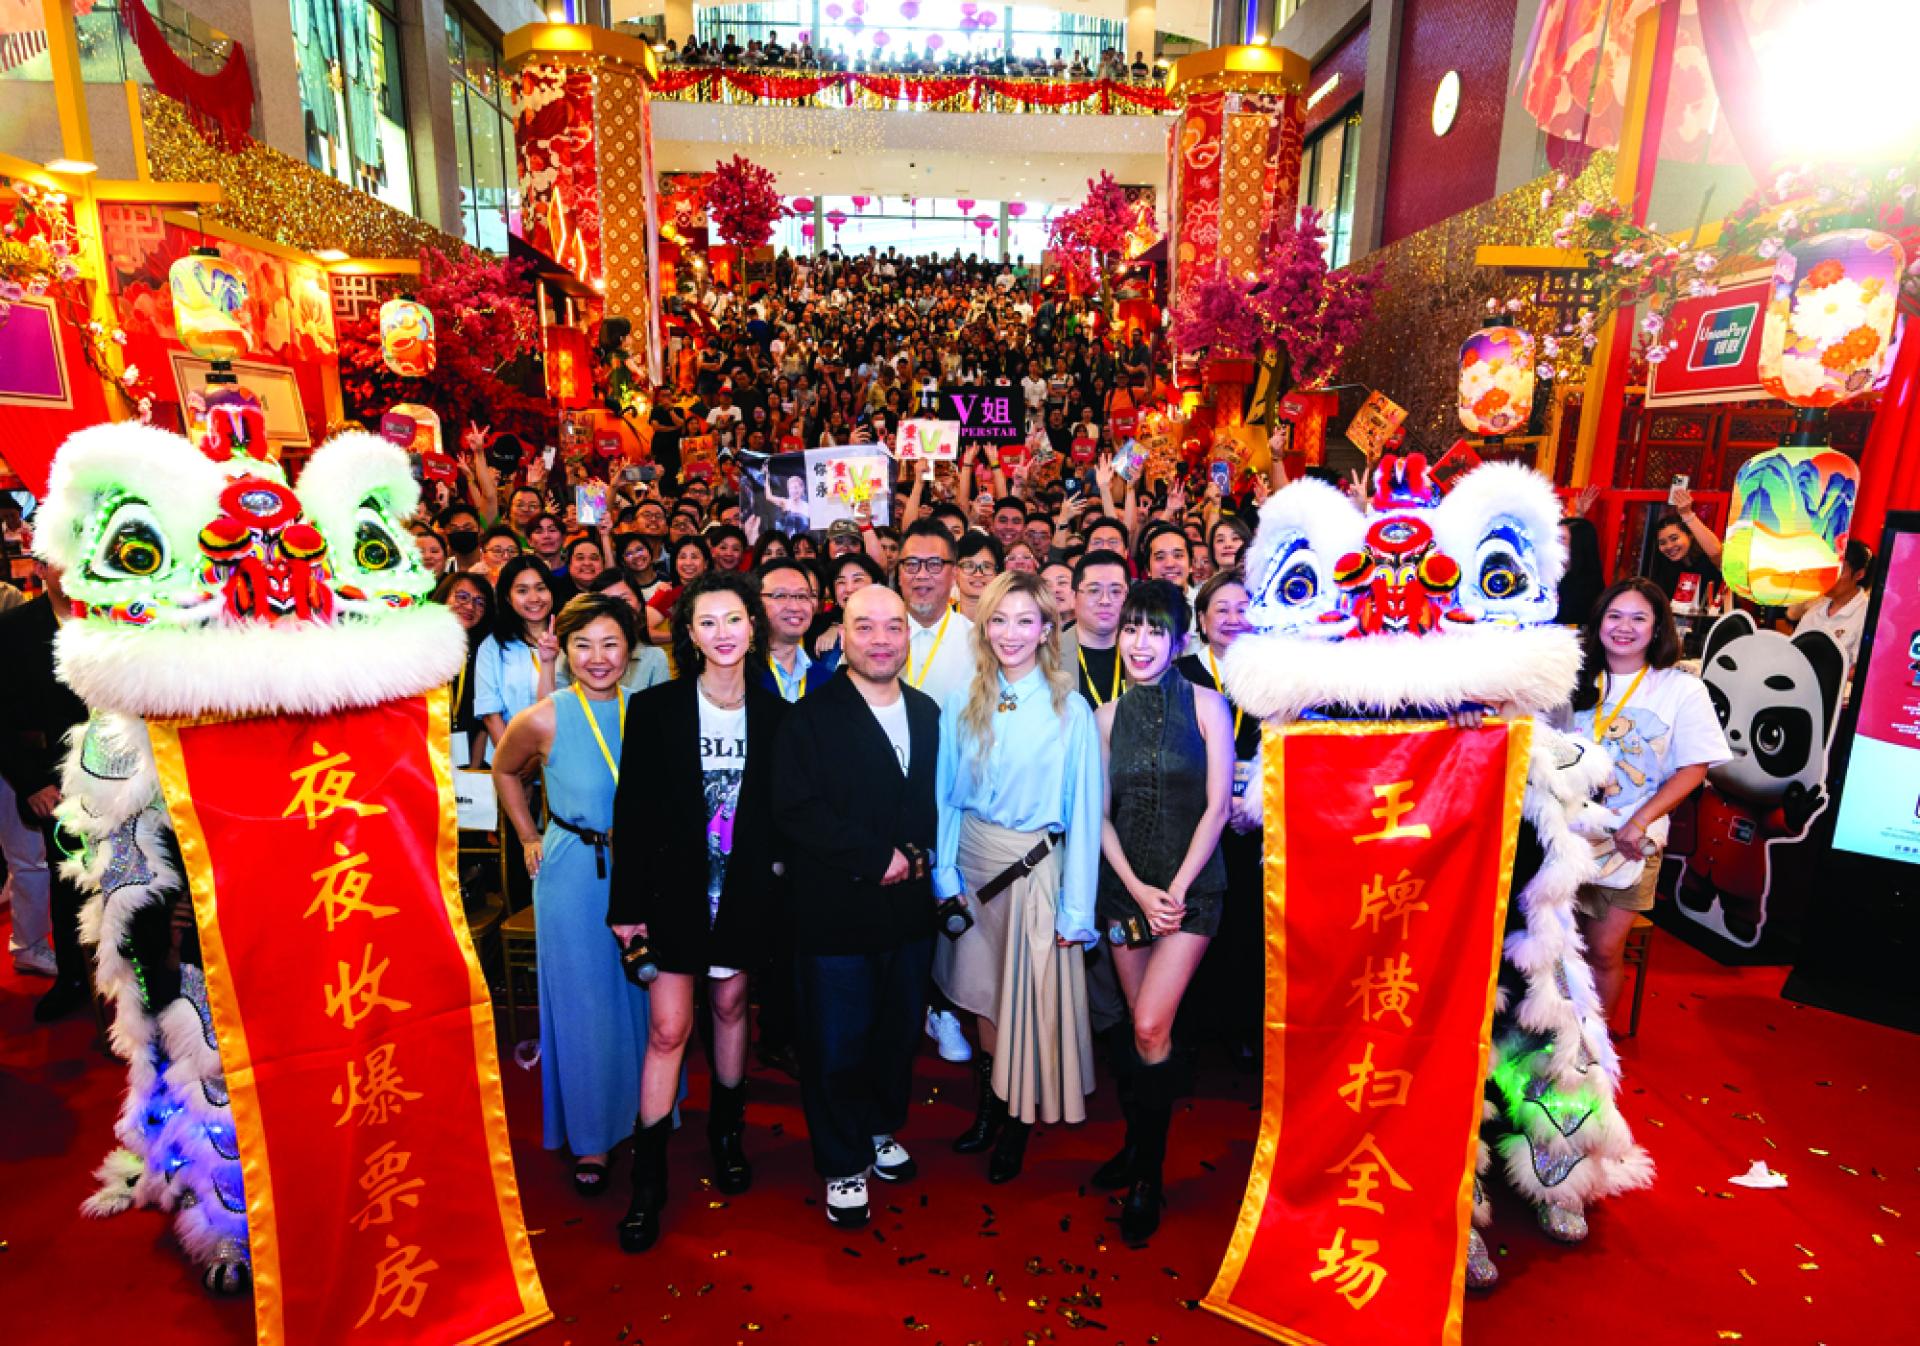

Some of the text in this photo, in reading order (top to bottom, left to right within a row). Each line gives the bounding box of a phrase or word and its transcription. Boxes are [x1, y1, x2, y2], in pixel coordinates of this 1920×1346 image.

[1699, 322, 1748, 342] UnionPay
[950, 394, 1012, 425] V姐
[961, 427, 1017, 437] PERSTAR
[282, 741, 440, 1329] 夜夜收爆票房
[1311, 780, 1431, 1310] 王牌横扫全场
